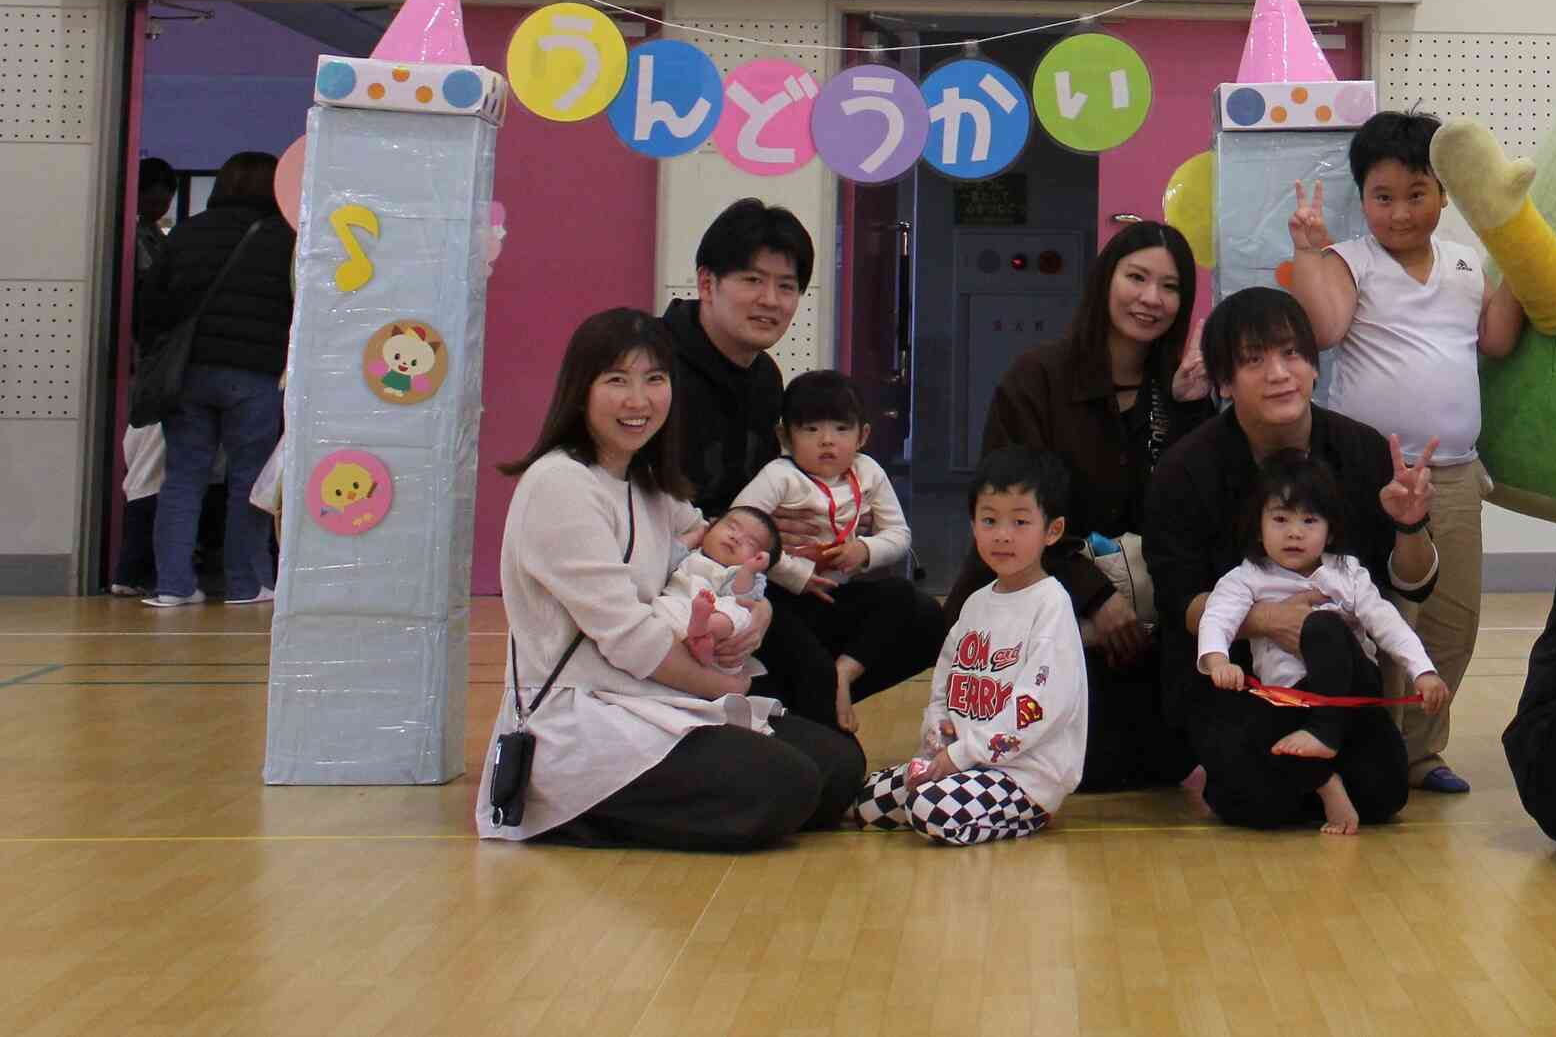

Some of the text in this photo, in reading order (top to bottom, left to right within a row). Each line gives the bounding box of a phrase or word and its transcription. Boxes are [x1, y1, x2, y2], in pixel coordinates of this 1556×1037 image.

[537, 14, 1131, 174] うんどうかい
[951, 627, 991, 671] OM
[946, 672, 1014, 721] ERRY
